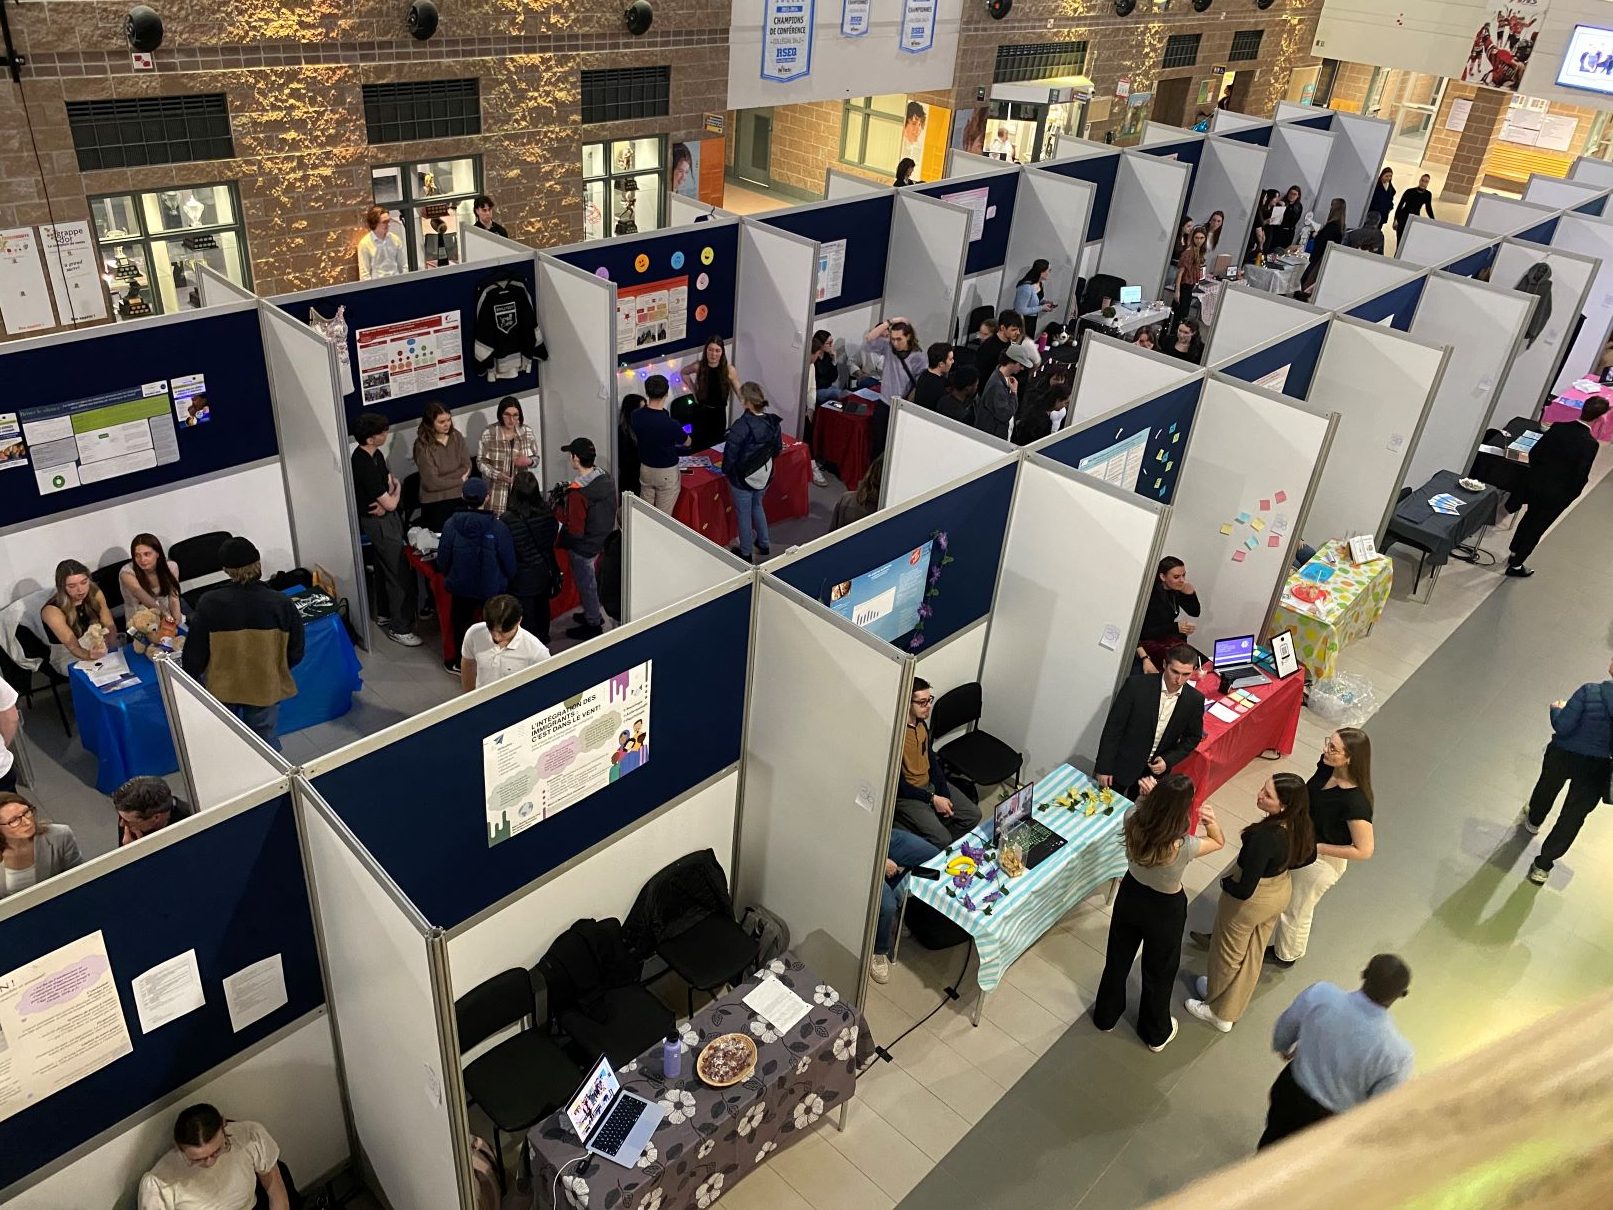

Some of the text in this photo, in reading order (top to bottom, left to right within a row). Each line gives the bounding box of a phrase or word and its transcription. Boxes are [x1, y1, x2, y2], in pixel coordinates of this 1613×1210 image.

[773, 16, 804, 25] CHAMPIONS
[777, 25, 806, 35] CONFÉRENCE
[776, 47, 797, 57] RSEQ
[56, 228, 83, 239] grappe
[531, 695, 596, 730] L'INTÉGRATION DES
[531, 711, 575, 737] IMMIGRANTS
[531, 728, 552, 743] C'EST
[552, 719, 572, 733] DANS
